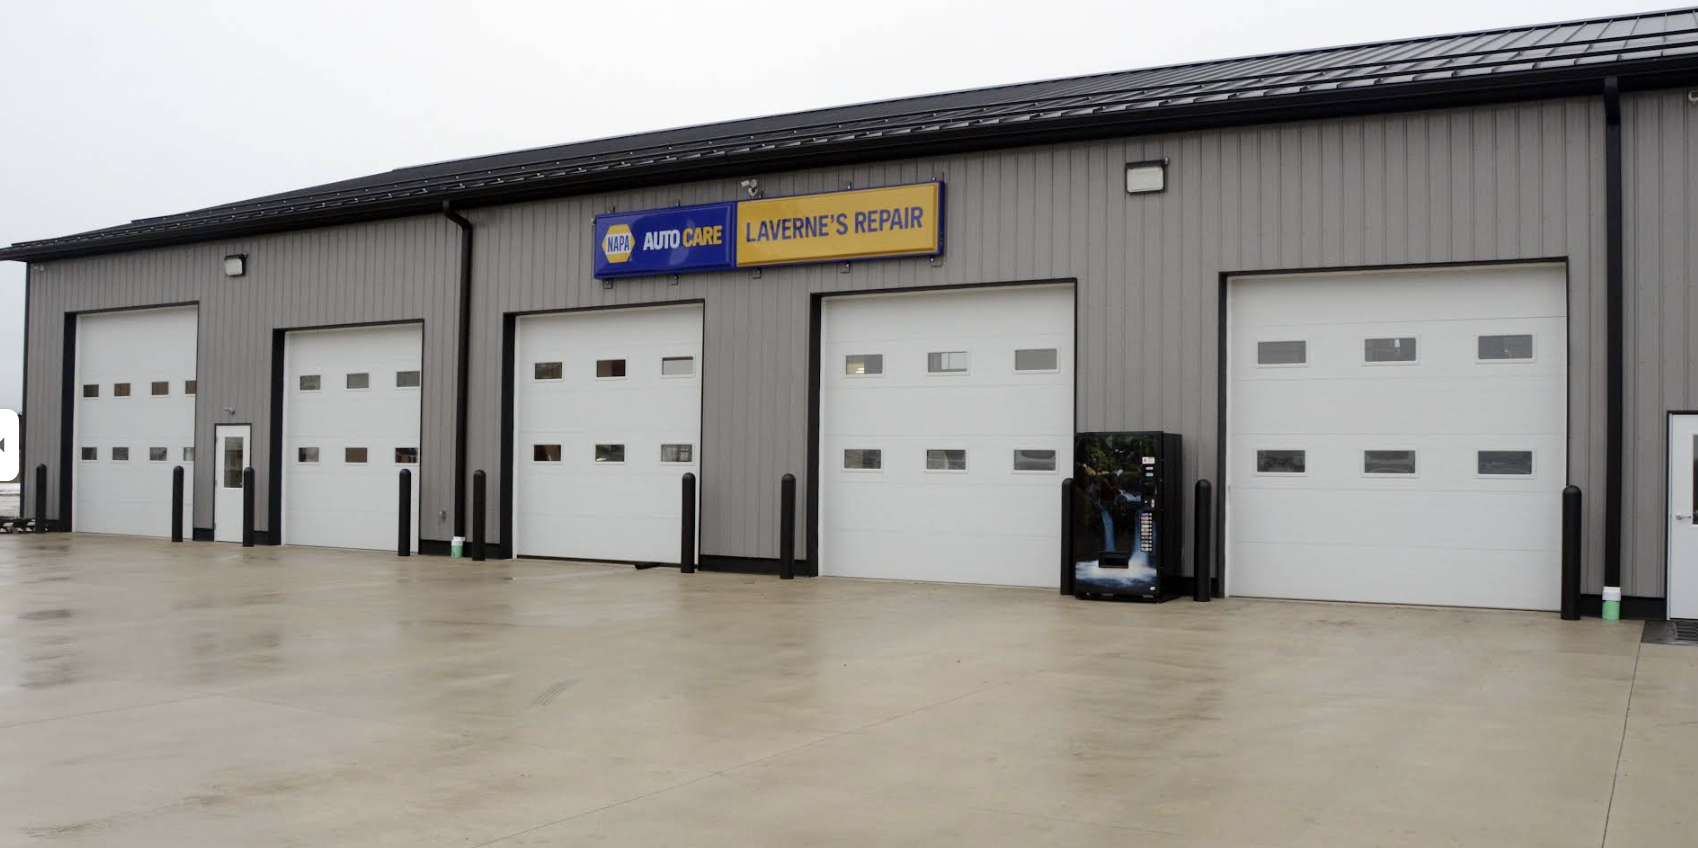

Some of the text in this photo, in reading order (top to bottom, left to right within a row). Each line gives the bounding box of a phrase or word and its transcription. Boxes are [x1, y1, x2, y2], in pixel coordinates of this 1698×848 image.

[745, 206, 924, 243] LAVERNE'S REPAIR
[607, 234, 630, 253] NAPA
[643, 225, 722, 251] AUTO CARE
